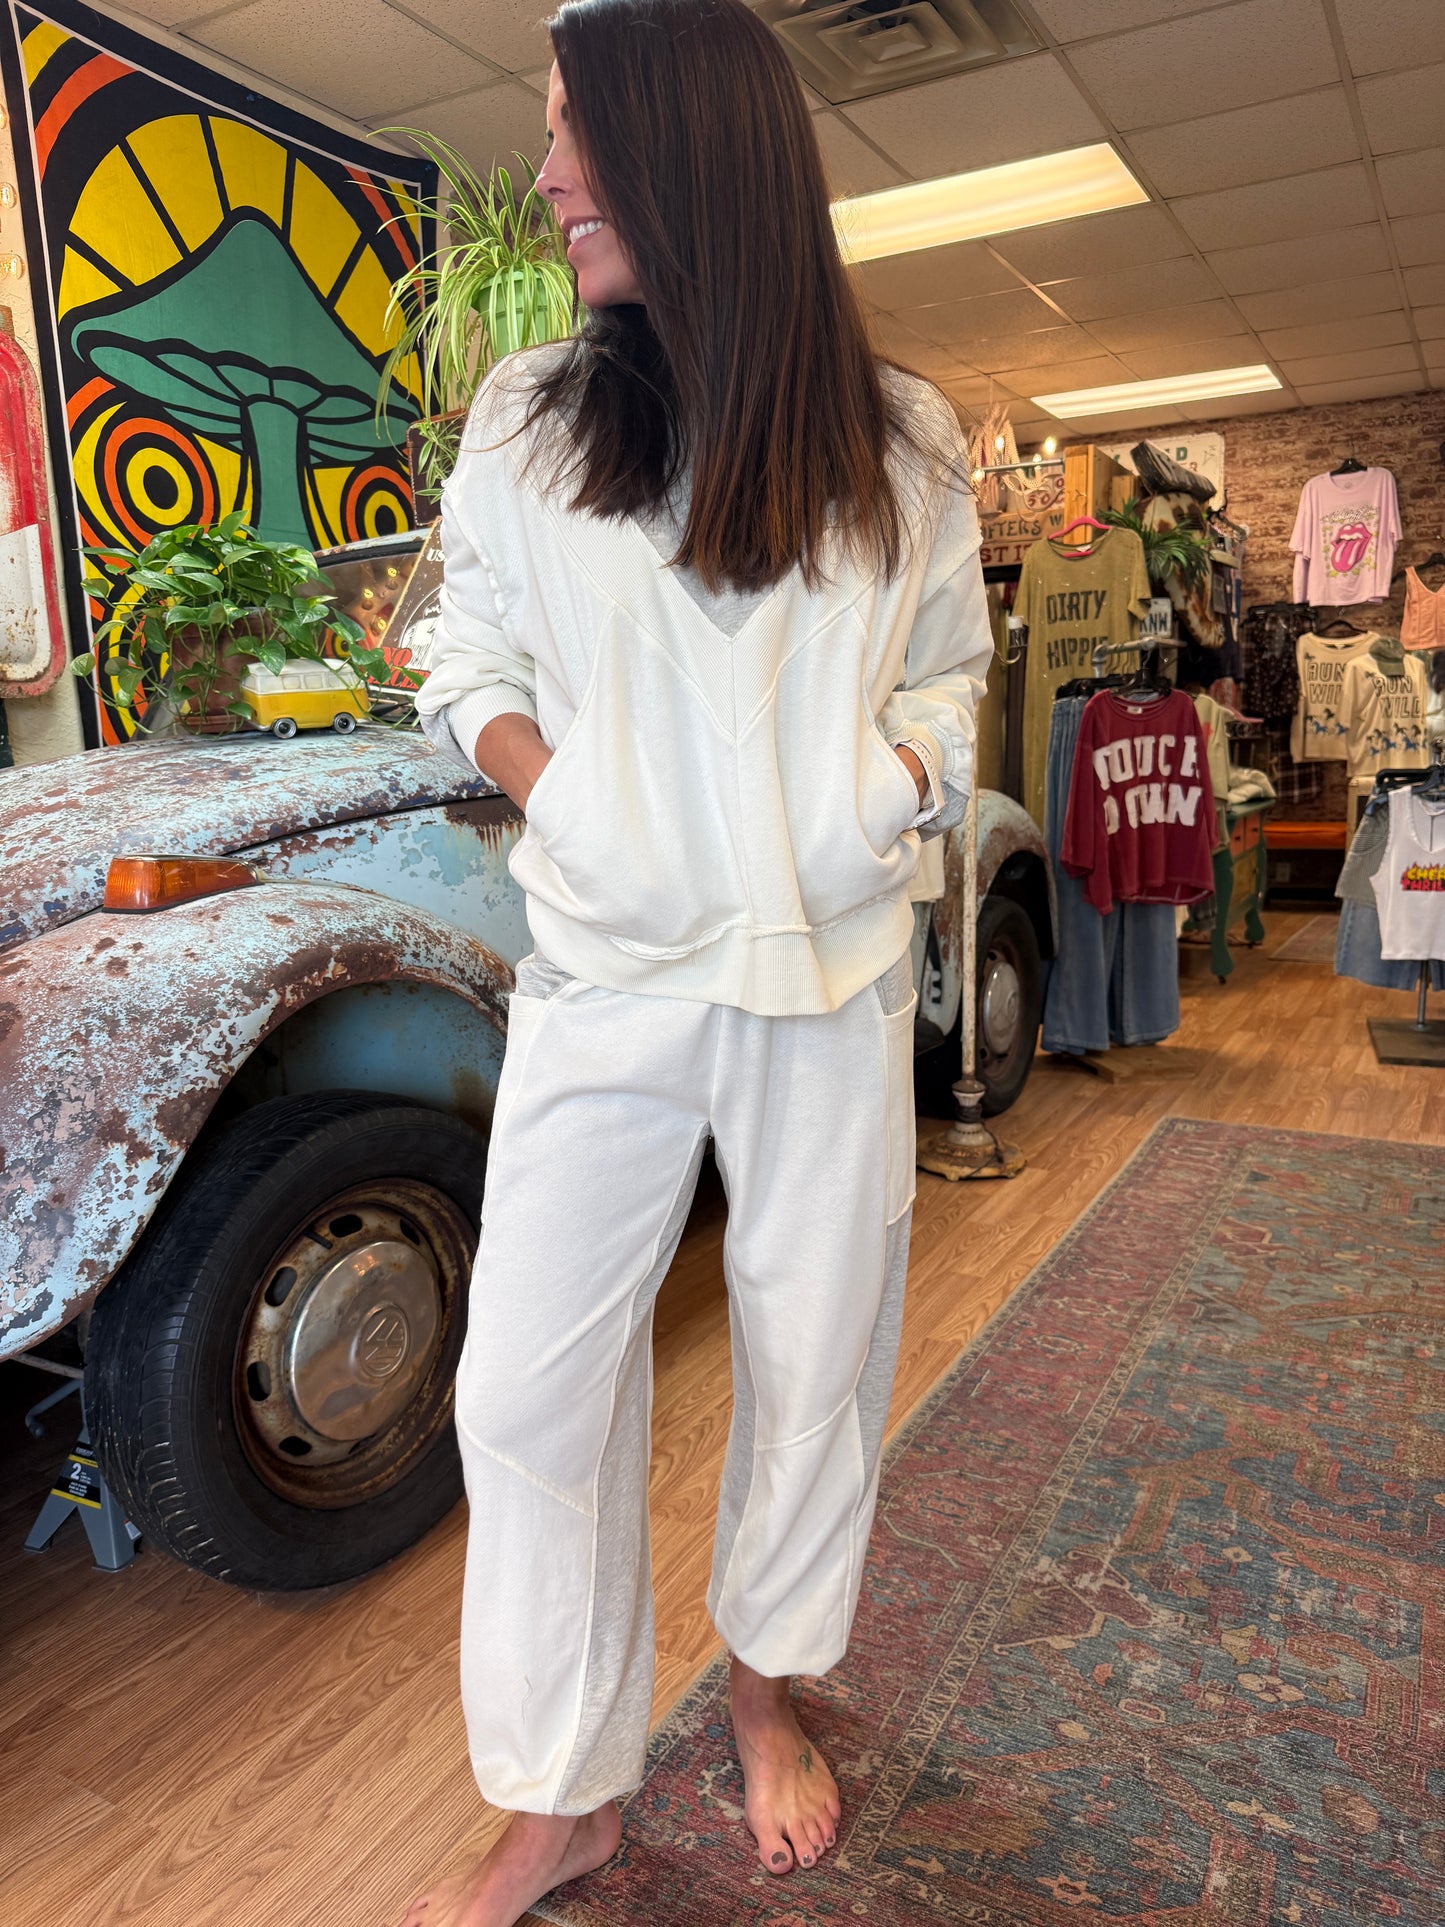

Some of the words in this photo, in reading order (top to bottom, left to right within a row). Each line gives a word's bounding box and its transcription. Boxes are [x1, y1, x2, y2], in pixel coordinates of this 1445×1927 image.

[1046, 590, 1107, 625] DIRTY
[1046, 636, 1108, 670] HIPPI
[70, 1463, 82, 1481] 2
